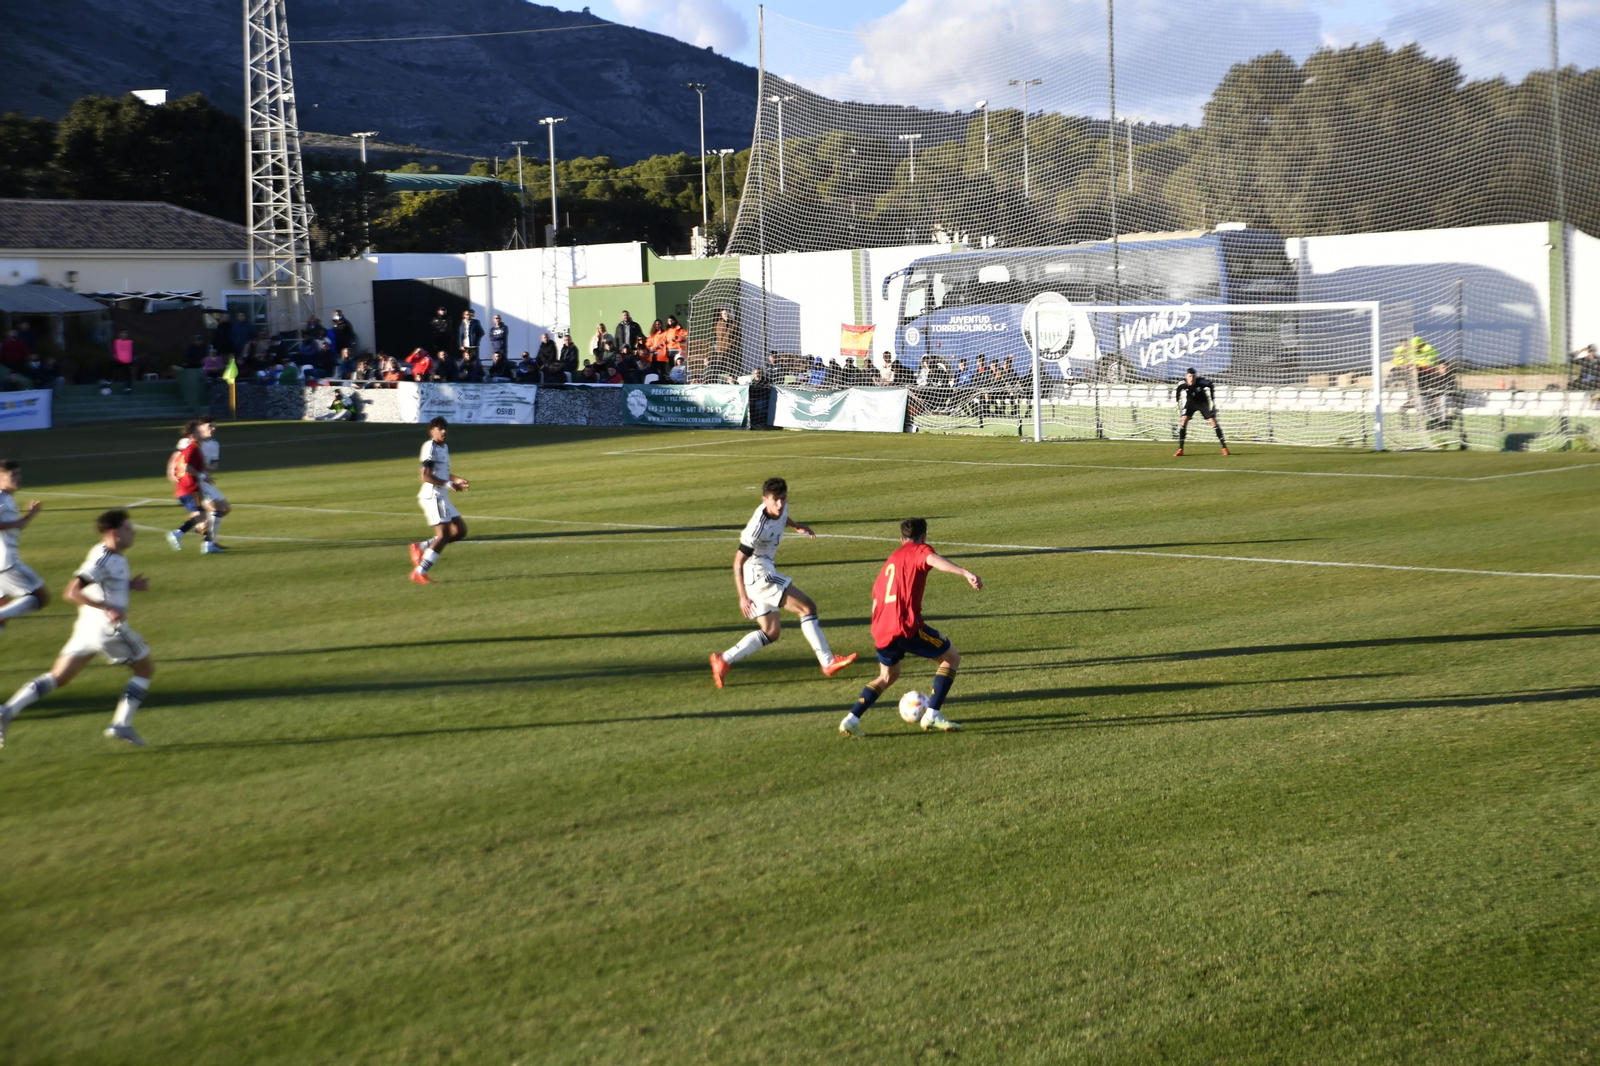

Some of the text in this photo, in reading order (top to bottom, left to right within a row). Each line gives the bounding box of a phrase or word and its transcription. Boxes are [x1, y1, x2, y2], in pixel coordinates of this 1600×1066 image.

[931, 323, 1009, 333] TORREMOLINOS C.F.
[949, 315, 990, 324] JUVENTUD
[1119, 302, 1191, 349] ¡VAMOS
[1139, 323, 1219, 369] VERDES!
[885, 563, 896, 604] 2
